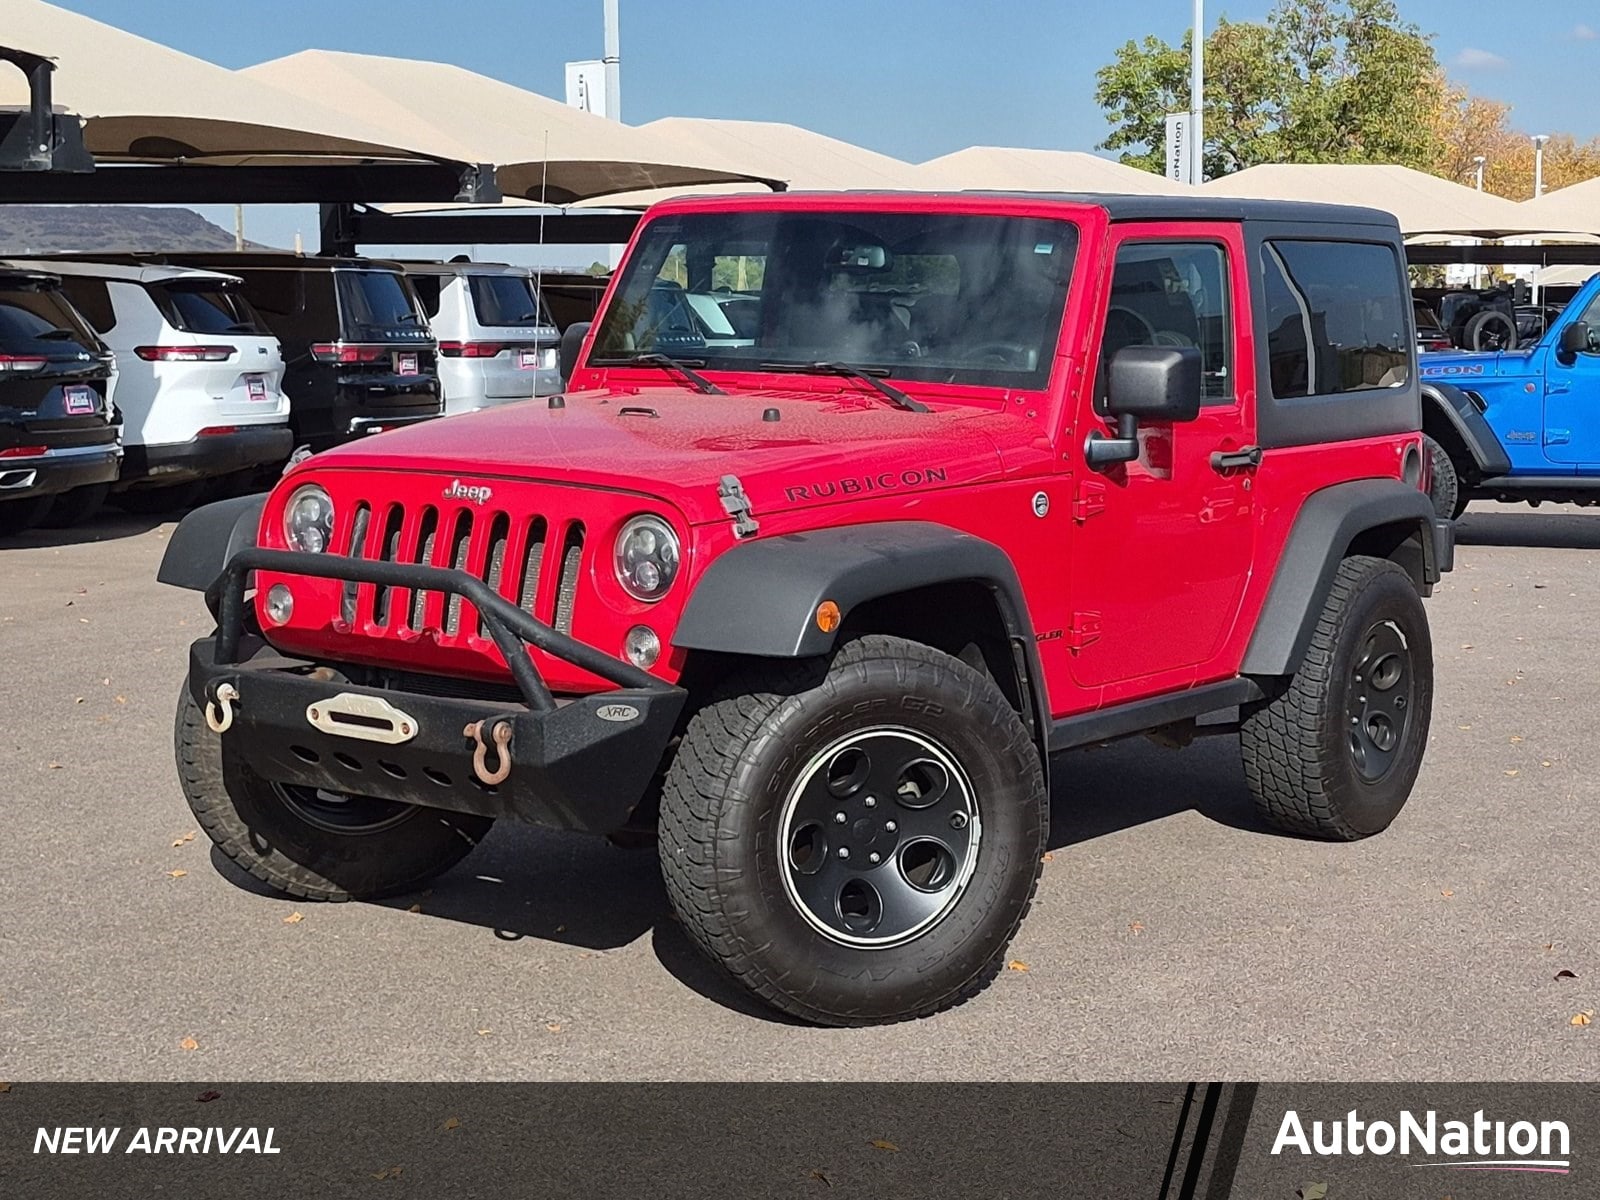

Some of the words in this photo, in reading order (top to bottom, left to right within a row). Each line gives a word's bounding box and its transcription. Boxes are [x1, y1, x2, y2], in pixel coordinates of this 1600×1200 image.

[442, 479, 492, 505] Jeep
[784, 467, 948, 502] RUBICON
[604, 706, 632, 718] XRC
